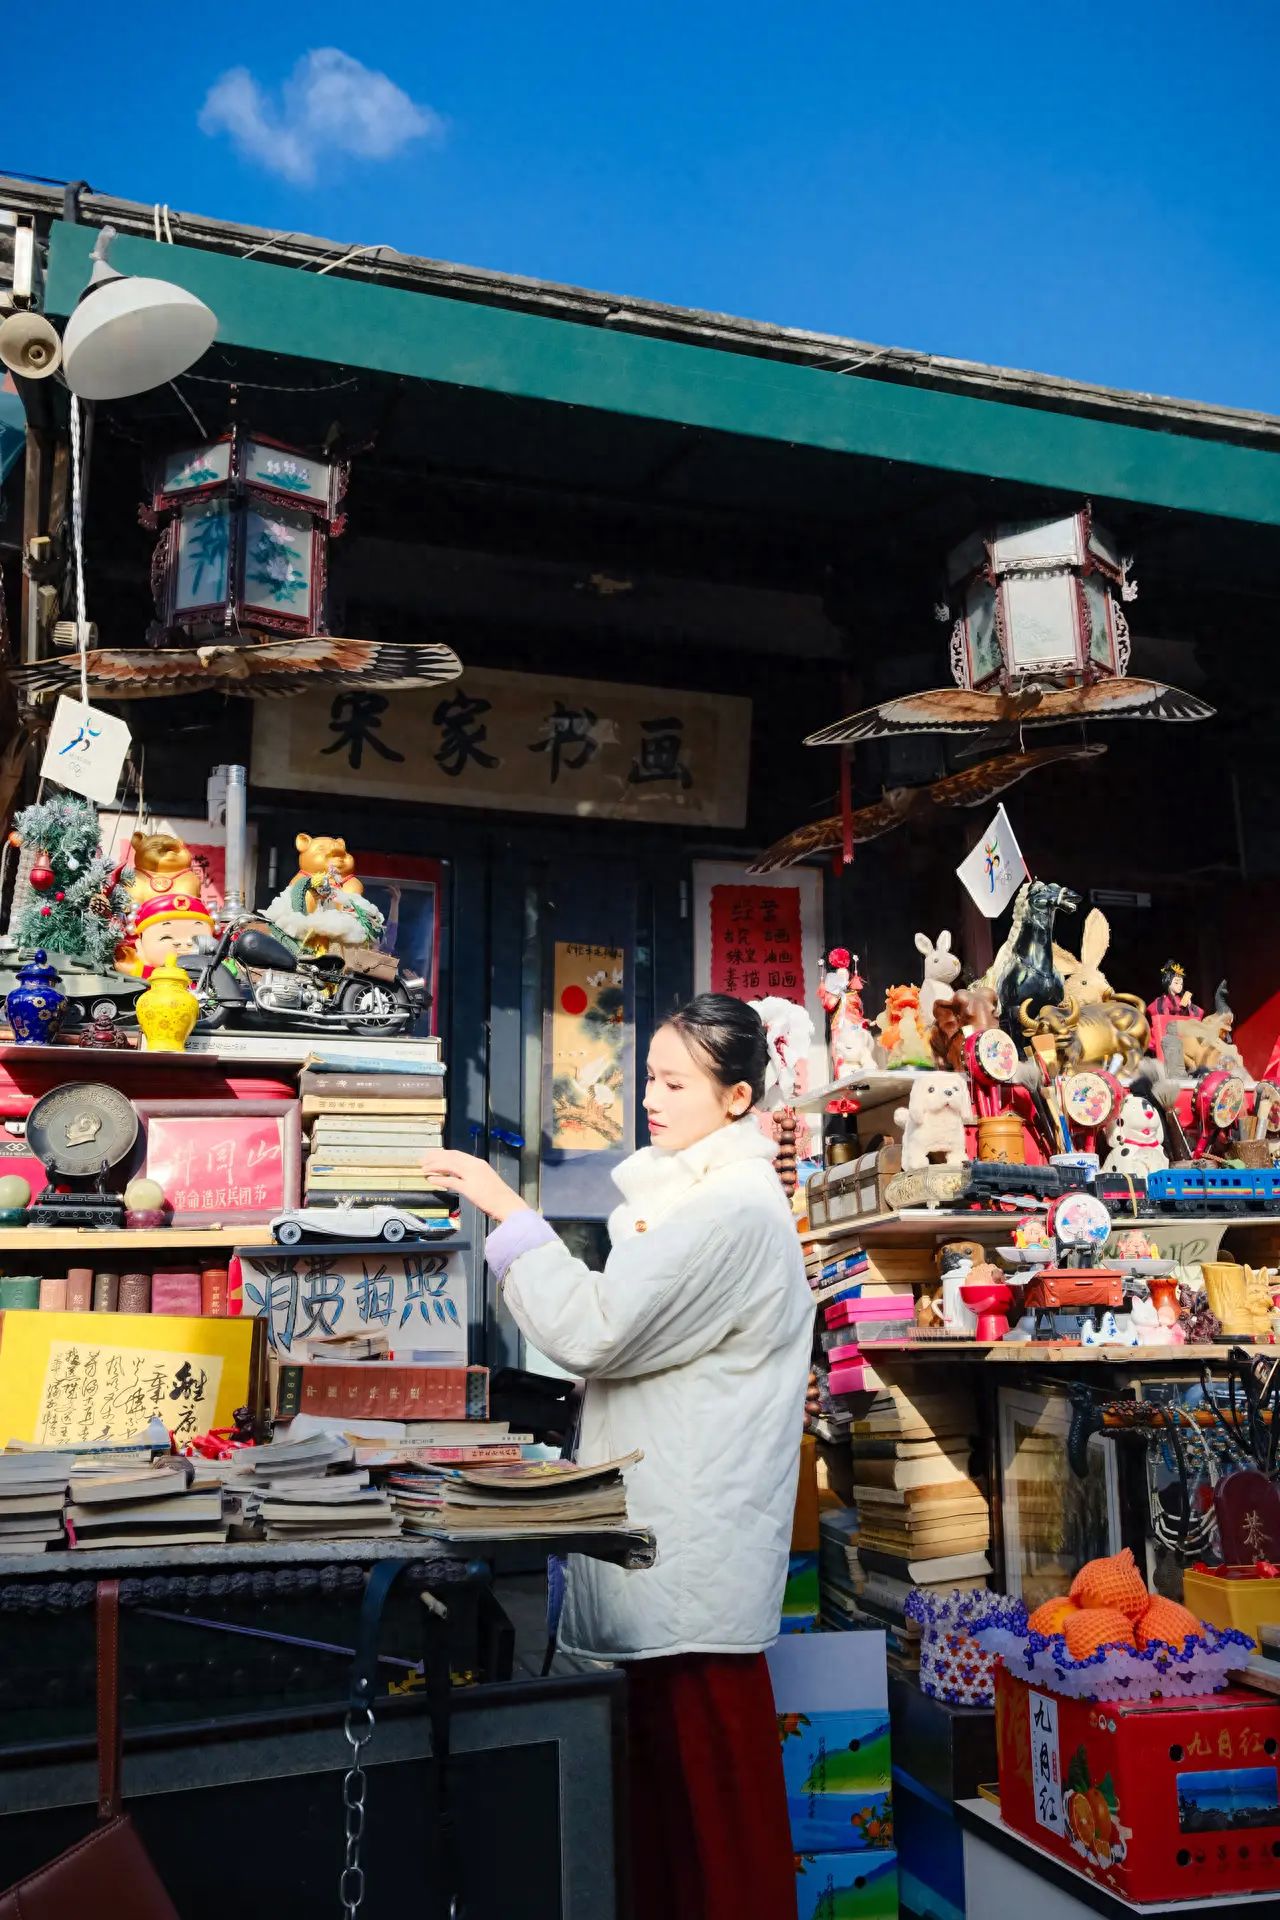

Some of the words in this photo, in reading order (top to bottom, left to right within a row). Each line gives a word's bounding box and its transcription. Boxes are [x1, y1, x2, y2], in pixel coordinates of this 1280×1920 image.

[723, 967, 760, 992] 素描
[768, 970, 797, 987] 国画
[285, 1369, 297, 1409] 1984
[1034, 1700, 1058, 1821] 九月红
[1186, 1727, 1266, 1759] 九月红
